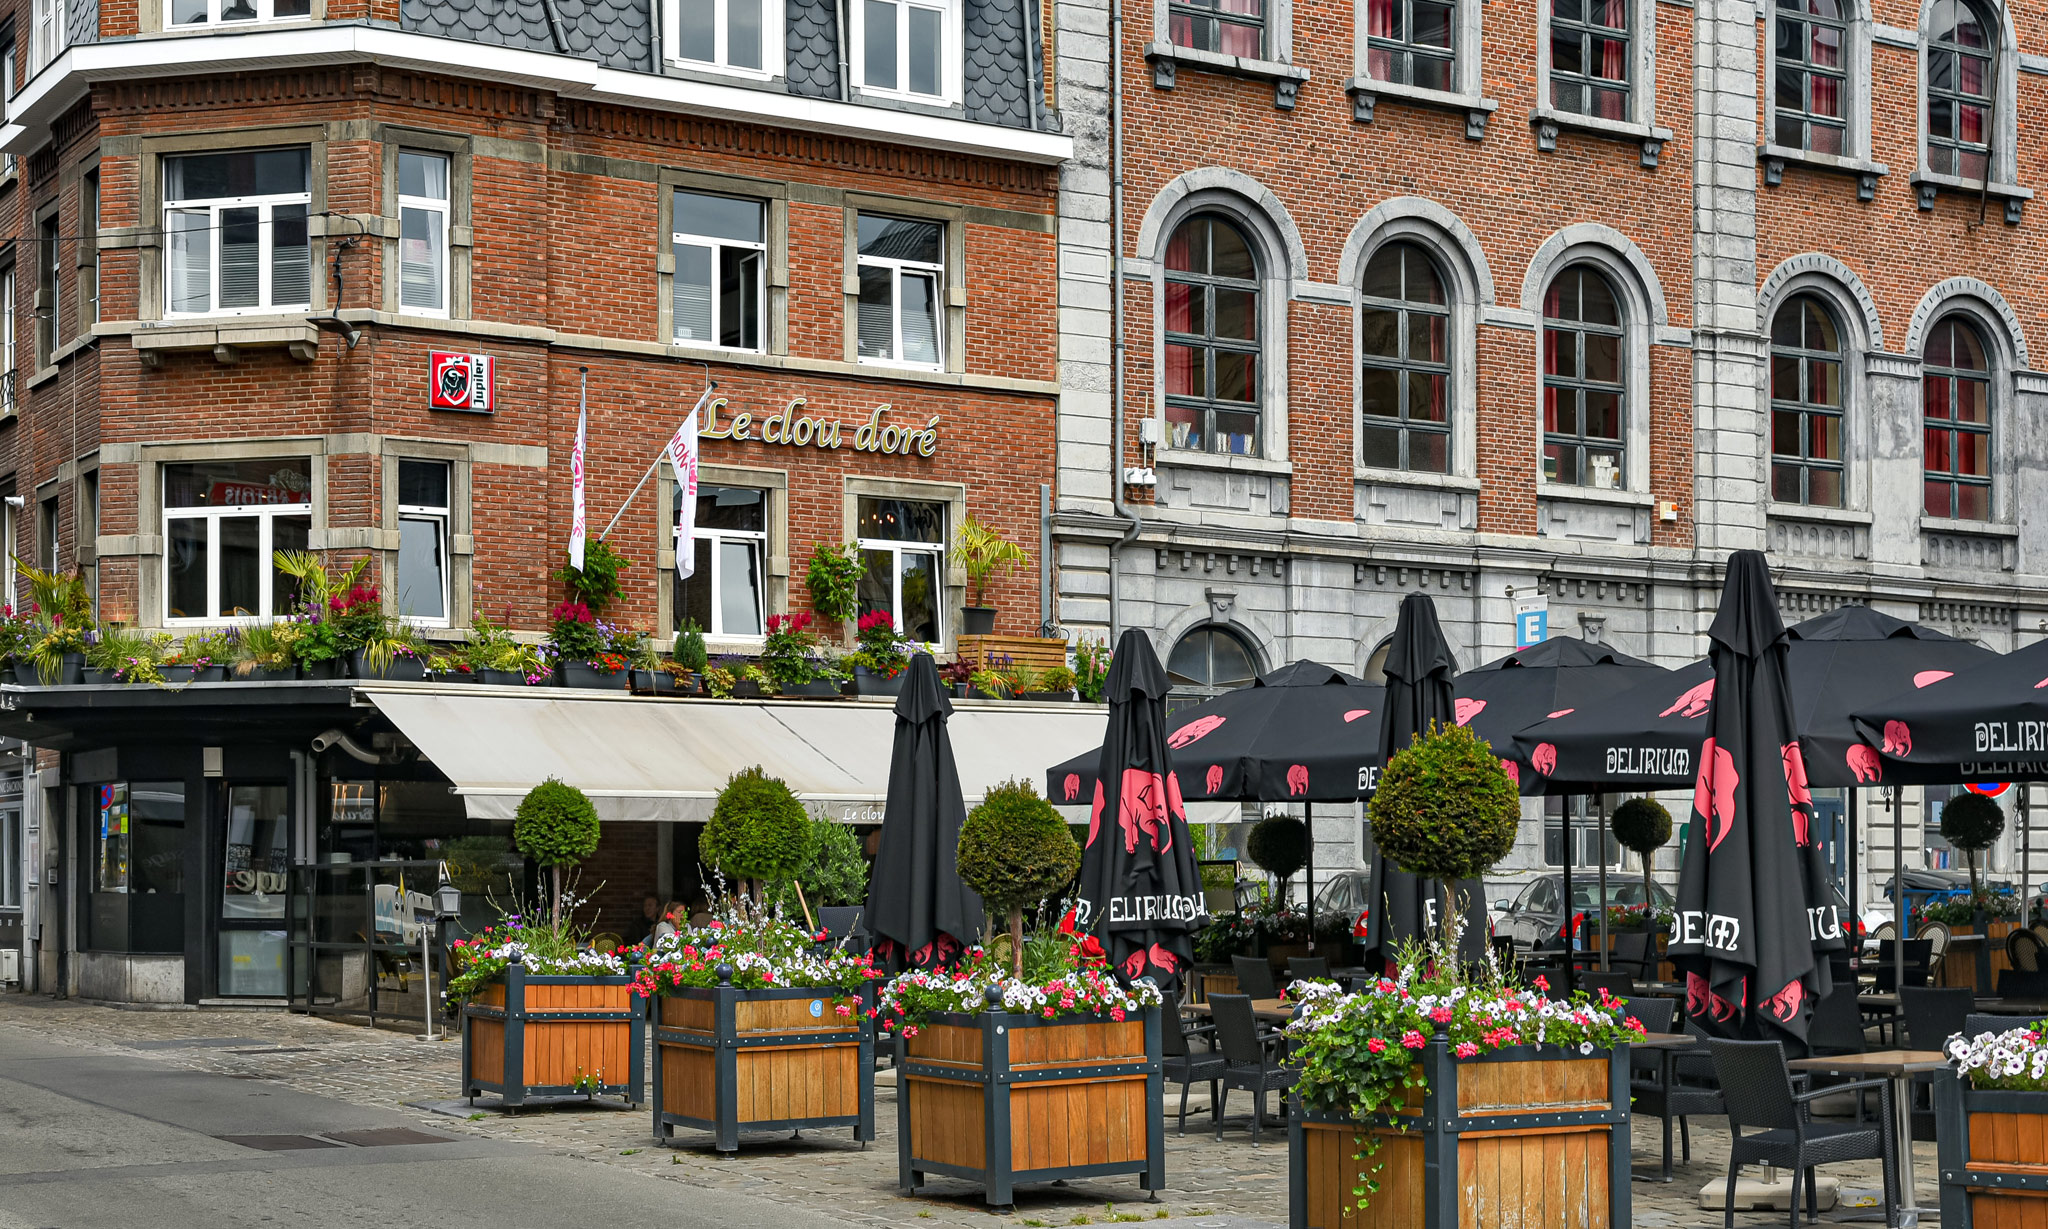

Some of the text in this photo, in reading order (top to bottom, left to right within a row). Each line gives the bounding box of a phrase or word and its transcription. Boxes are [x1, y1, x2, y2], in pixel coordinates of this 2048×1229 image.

[473, 358, 487, 408] Jupiler
[698, 398, 940, 457] Le clou doré
[1525, 615, 1540, 643] E
[1974, 720, 2048, 752] DELIRI
[1606, 747, 1690, 776] DELIRIUM
[842, 805, 885, 820] Le clou
